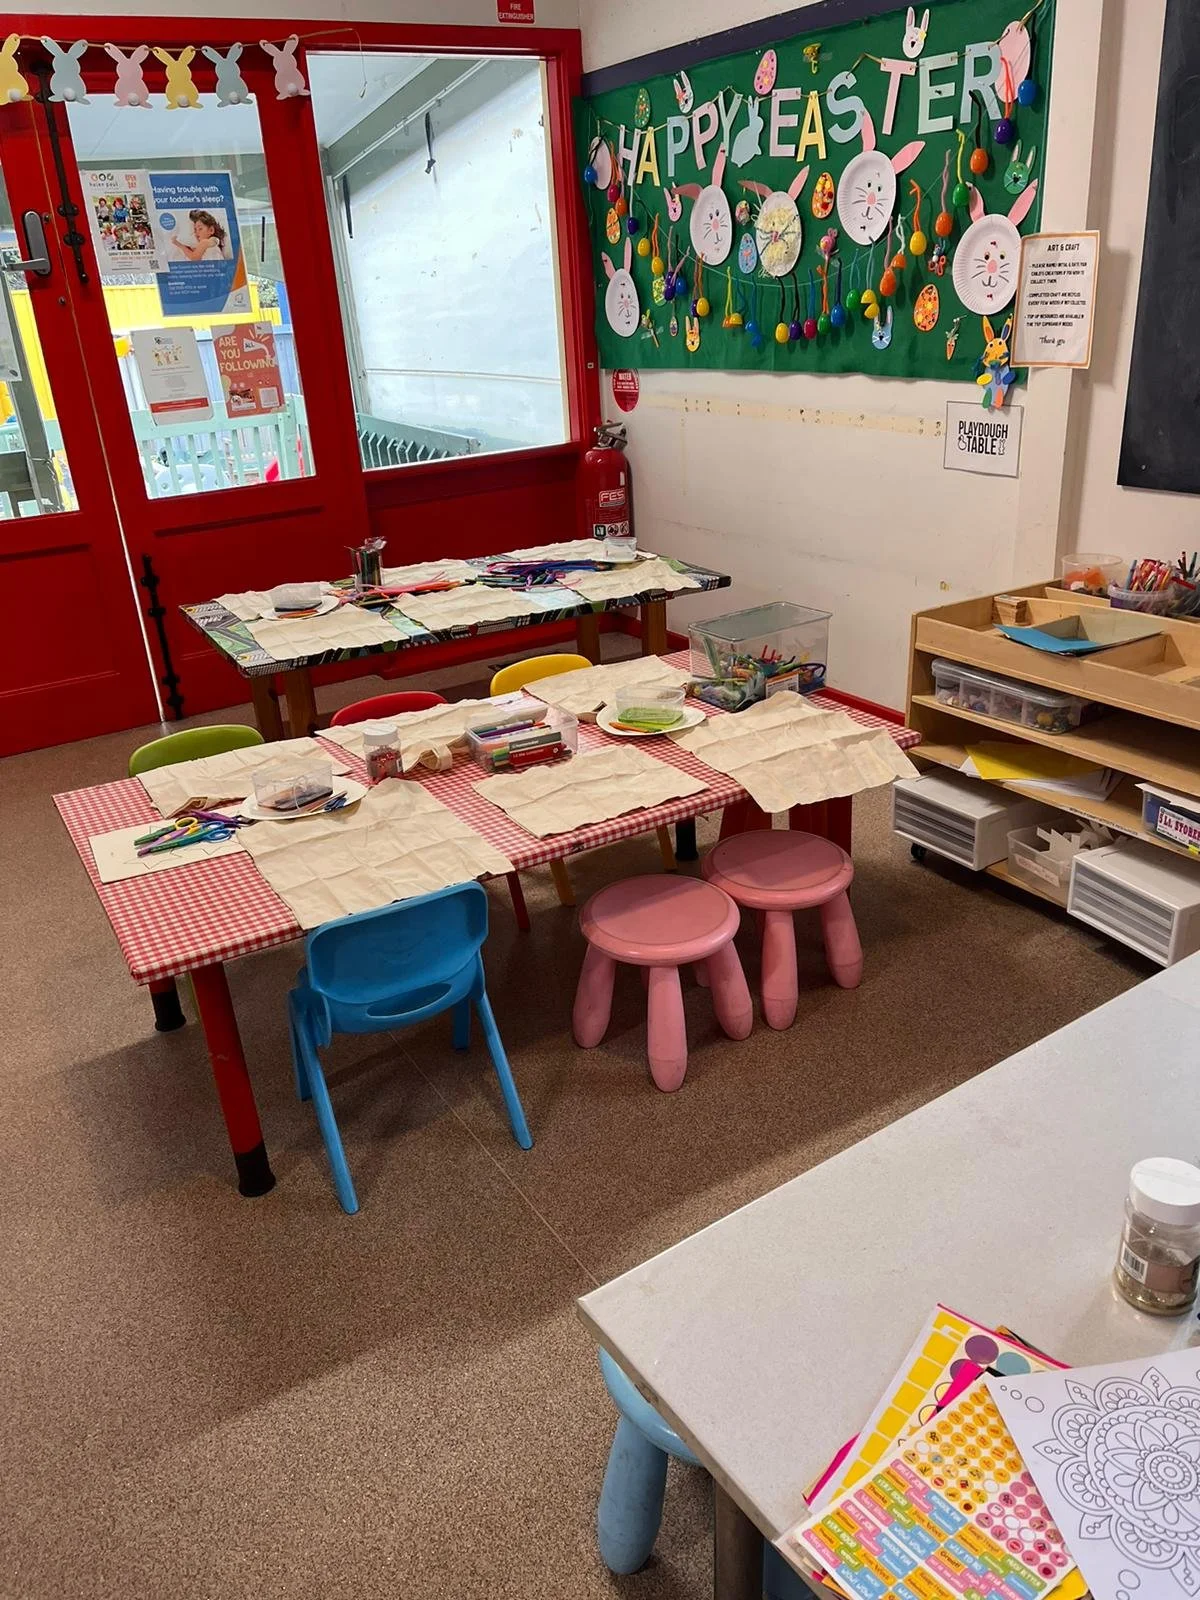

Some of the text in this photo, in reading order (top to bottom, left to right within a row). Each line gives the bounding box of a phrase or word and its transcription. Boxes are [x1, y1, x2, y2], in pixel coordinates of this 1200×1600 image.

[510, 3, 522, 11] FIRE
[499, 12, 534, 20] EXTINGUISHER
[617, 41, 1002, 187] HAPPY EASTER
[202, 194, 224, 204] sleep?
[1047, 243, 1080, 252] ART & CRAFT
[219, 336, 238, 348] ARE
[1039, 336, 1055, 344] Thank
[220, 348, 240, 360] YOU
[220, 358, 275, 372] FOLLOWING
[958, 420, 1009, 439] PLAYDOUGH
[966, 436, 998, 456] TABLE
[600, 490, 625, 502] FES
